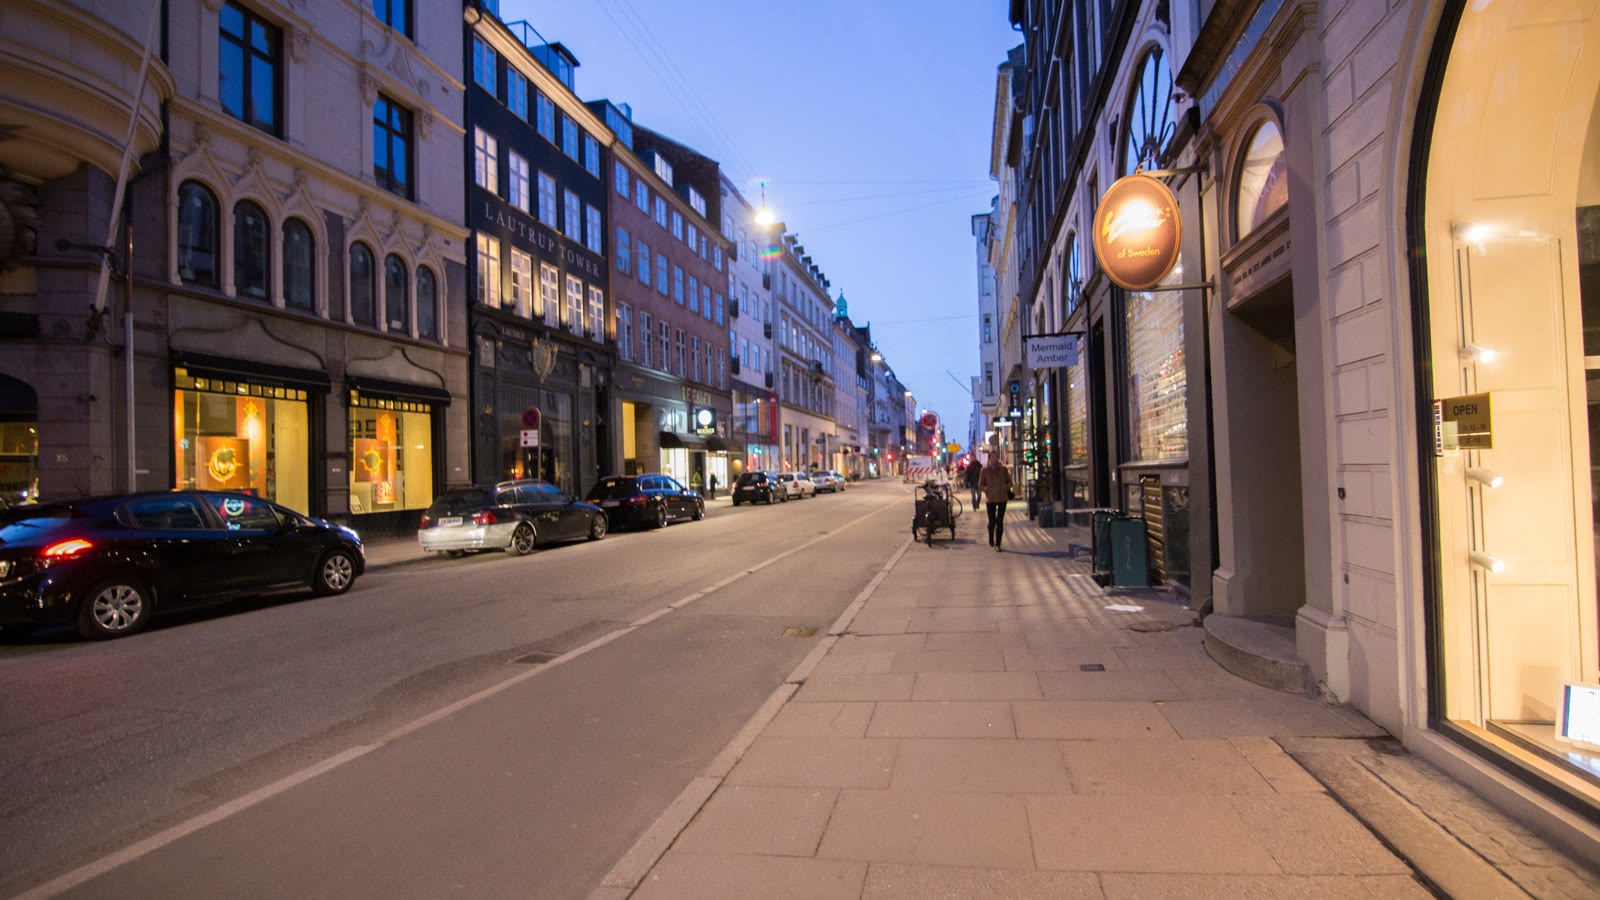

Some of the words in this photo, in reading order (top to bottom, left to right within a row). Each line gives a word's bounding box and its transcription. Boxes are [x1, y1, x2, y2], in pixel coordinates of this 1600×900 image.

[484, 201, 555, 252] LAUTRUP
[559, 244, 599, 277] TOWER
[1117, 248, 1126, 259] of
[1127, 246, 1160, 258] Sweden
[1031, 341, 1073, 353] Mermaid
[1036, 354, 1068, 363] Amber
[1452, 403, 1478, 416] OPEN
